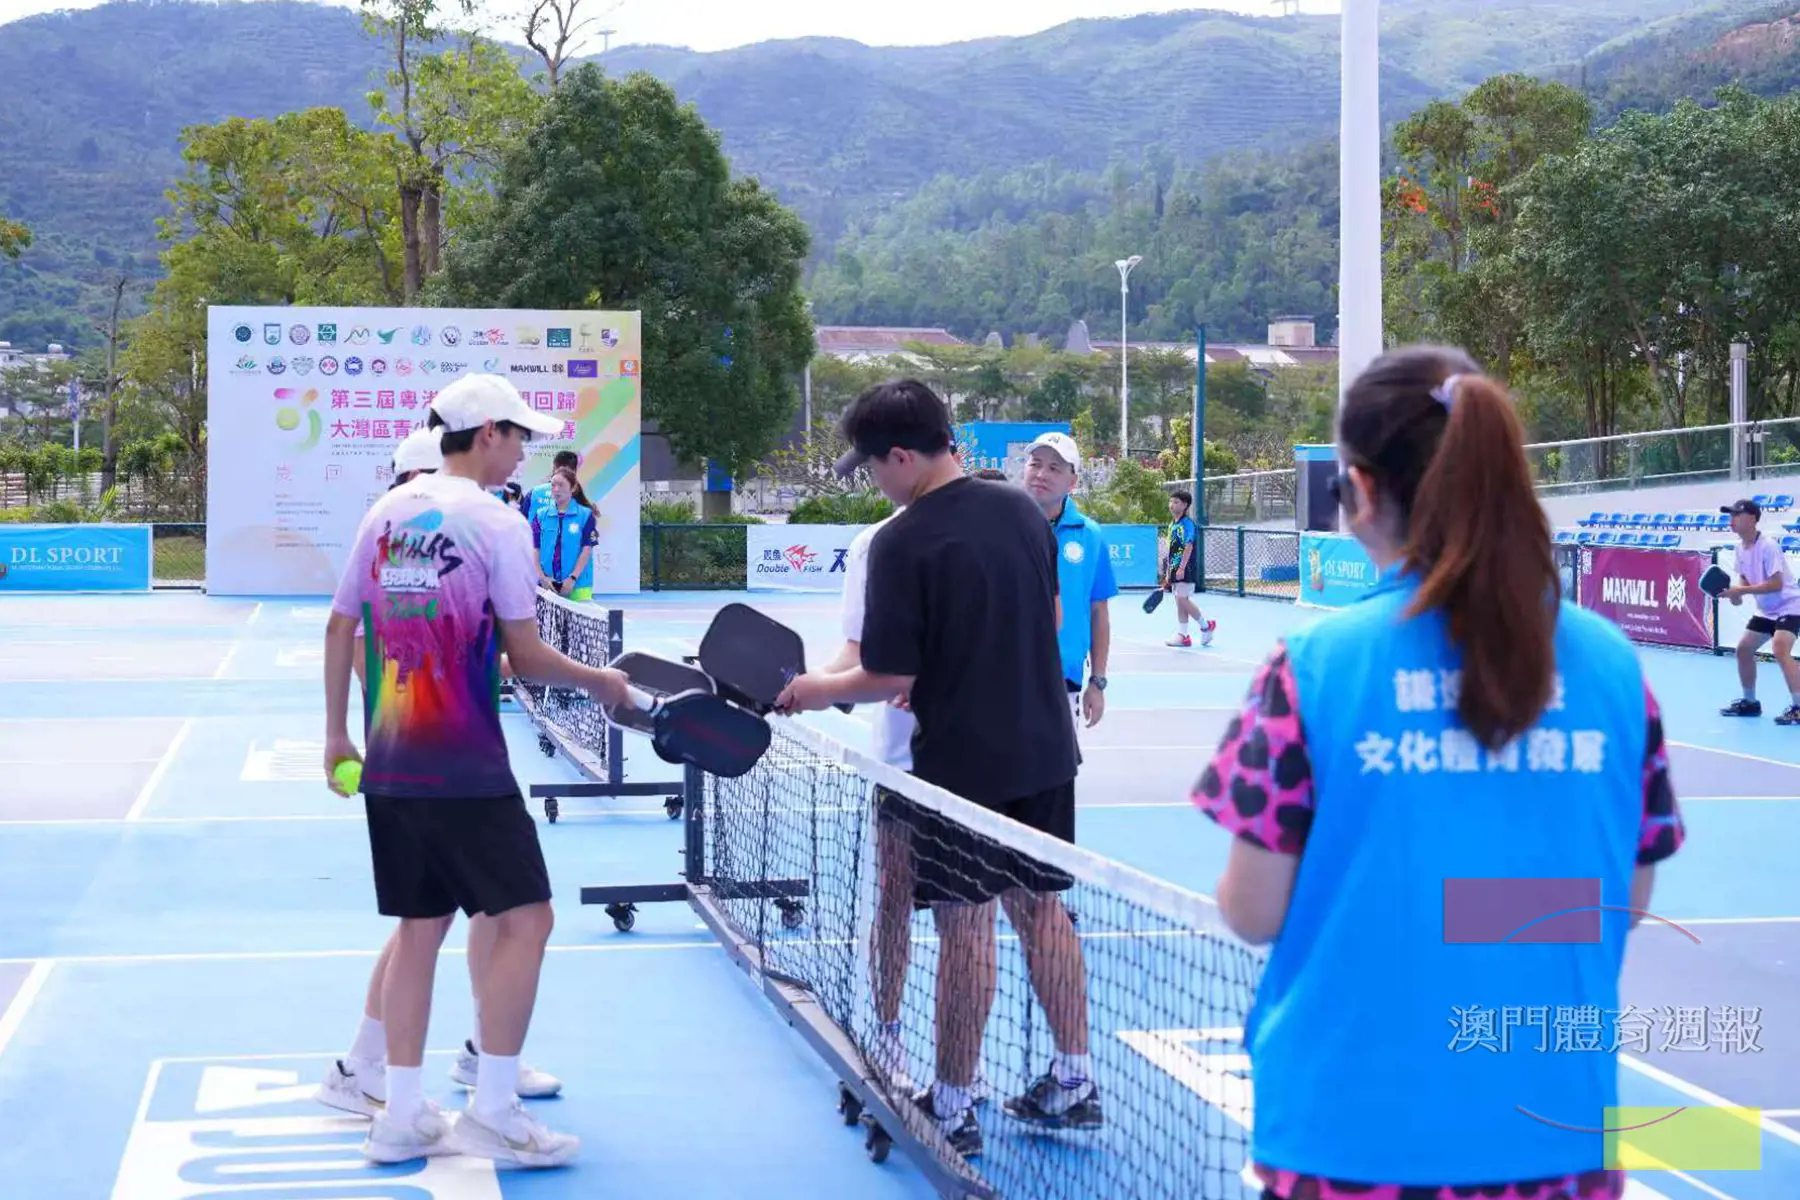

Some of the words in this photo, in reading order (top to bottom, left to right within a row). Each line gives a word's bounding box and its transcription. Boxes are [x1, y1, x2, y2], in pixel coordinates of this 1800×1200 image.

[11, 547, 41, 563] DL
[47, 547, 123, 563] SPORT
[756, 563, 790, 573] Double
[1602, 577, 1659, 608] MAXWILL
